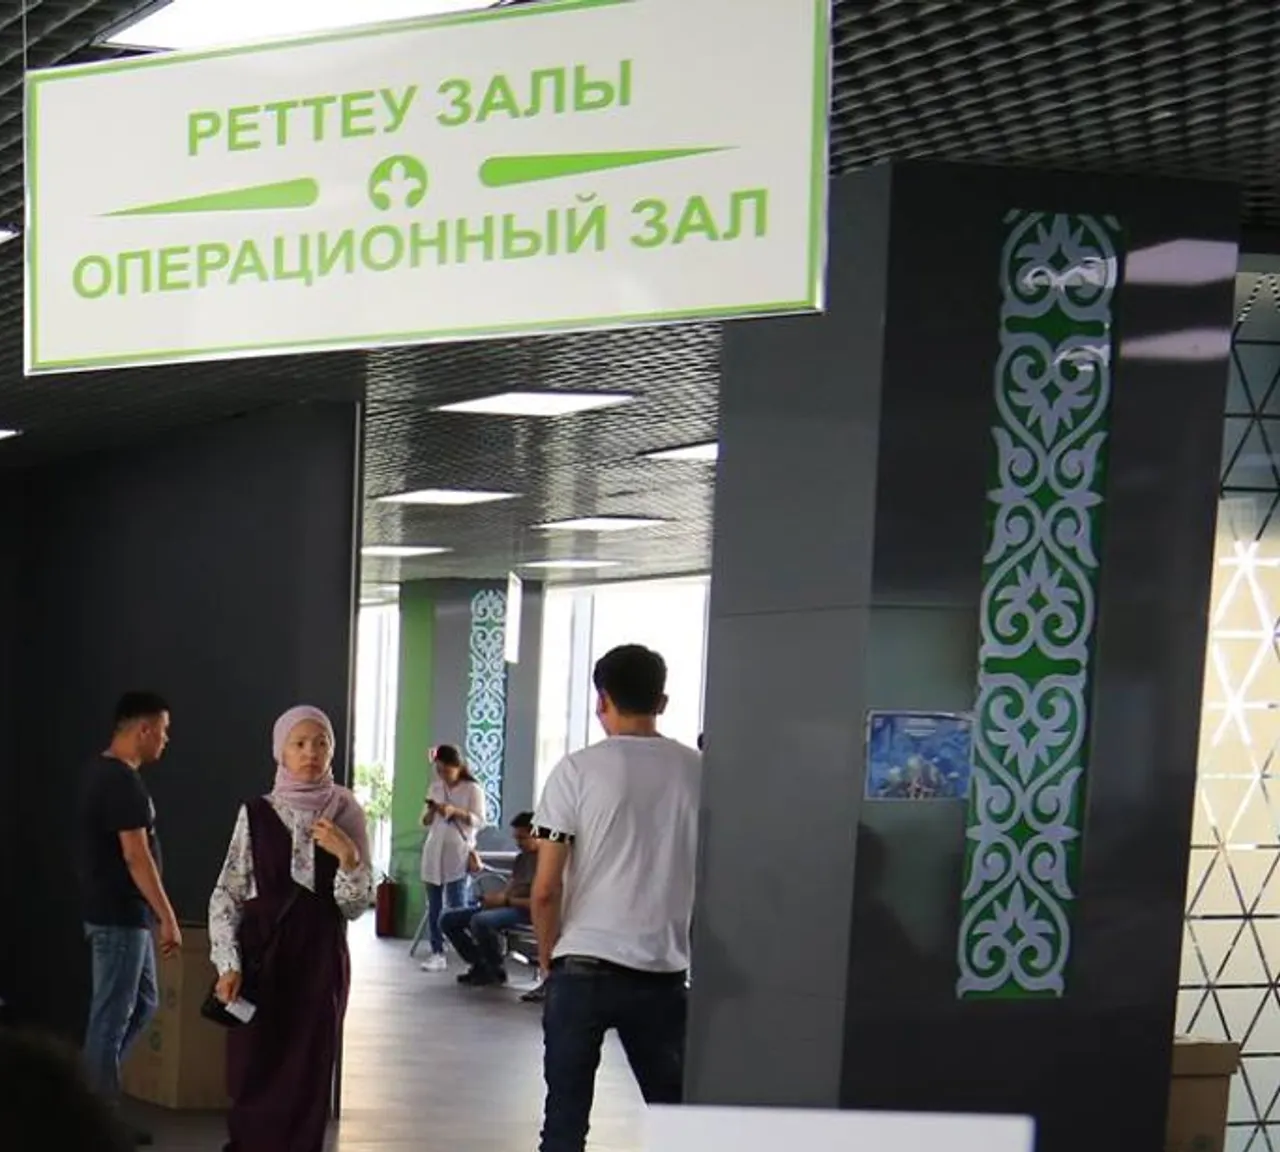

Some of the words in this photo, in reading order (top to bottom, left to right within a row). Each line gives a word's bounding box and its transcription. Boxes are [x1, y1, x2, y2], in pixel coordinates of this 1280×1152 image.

[186, 84, 419, 156] РЕТТЕУ
[436, 59, 634, 128] ЗАЛЫ
[71, 192, 608, 300] ОПЕРАЦИОННЫЙ
[629, 187, 771, 250] ЗАЛ
